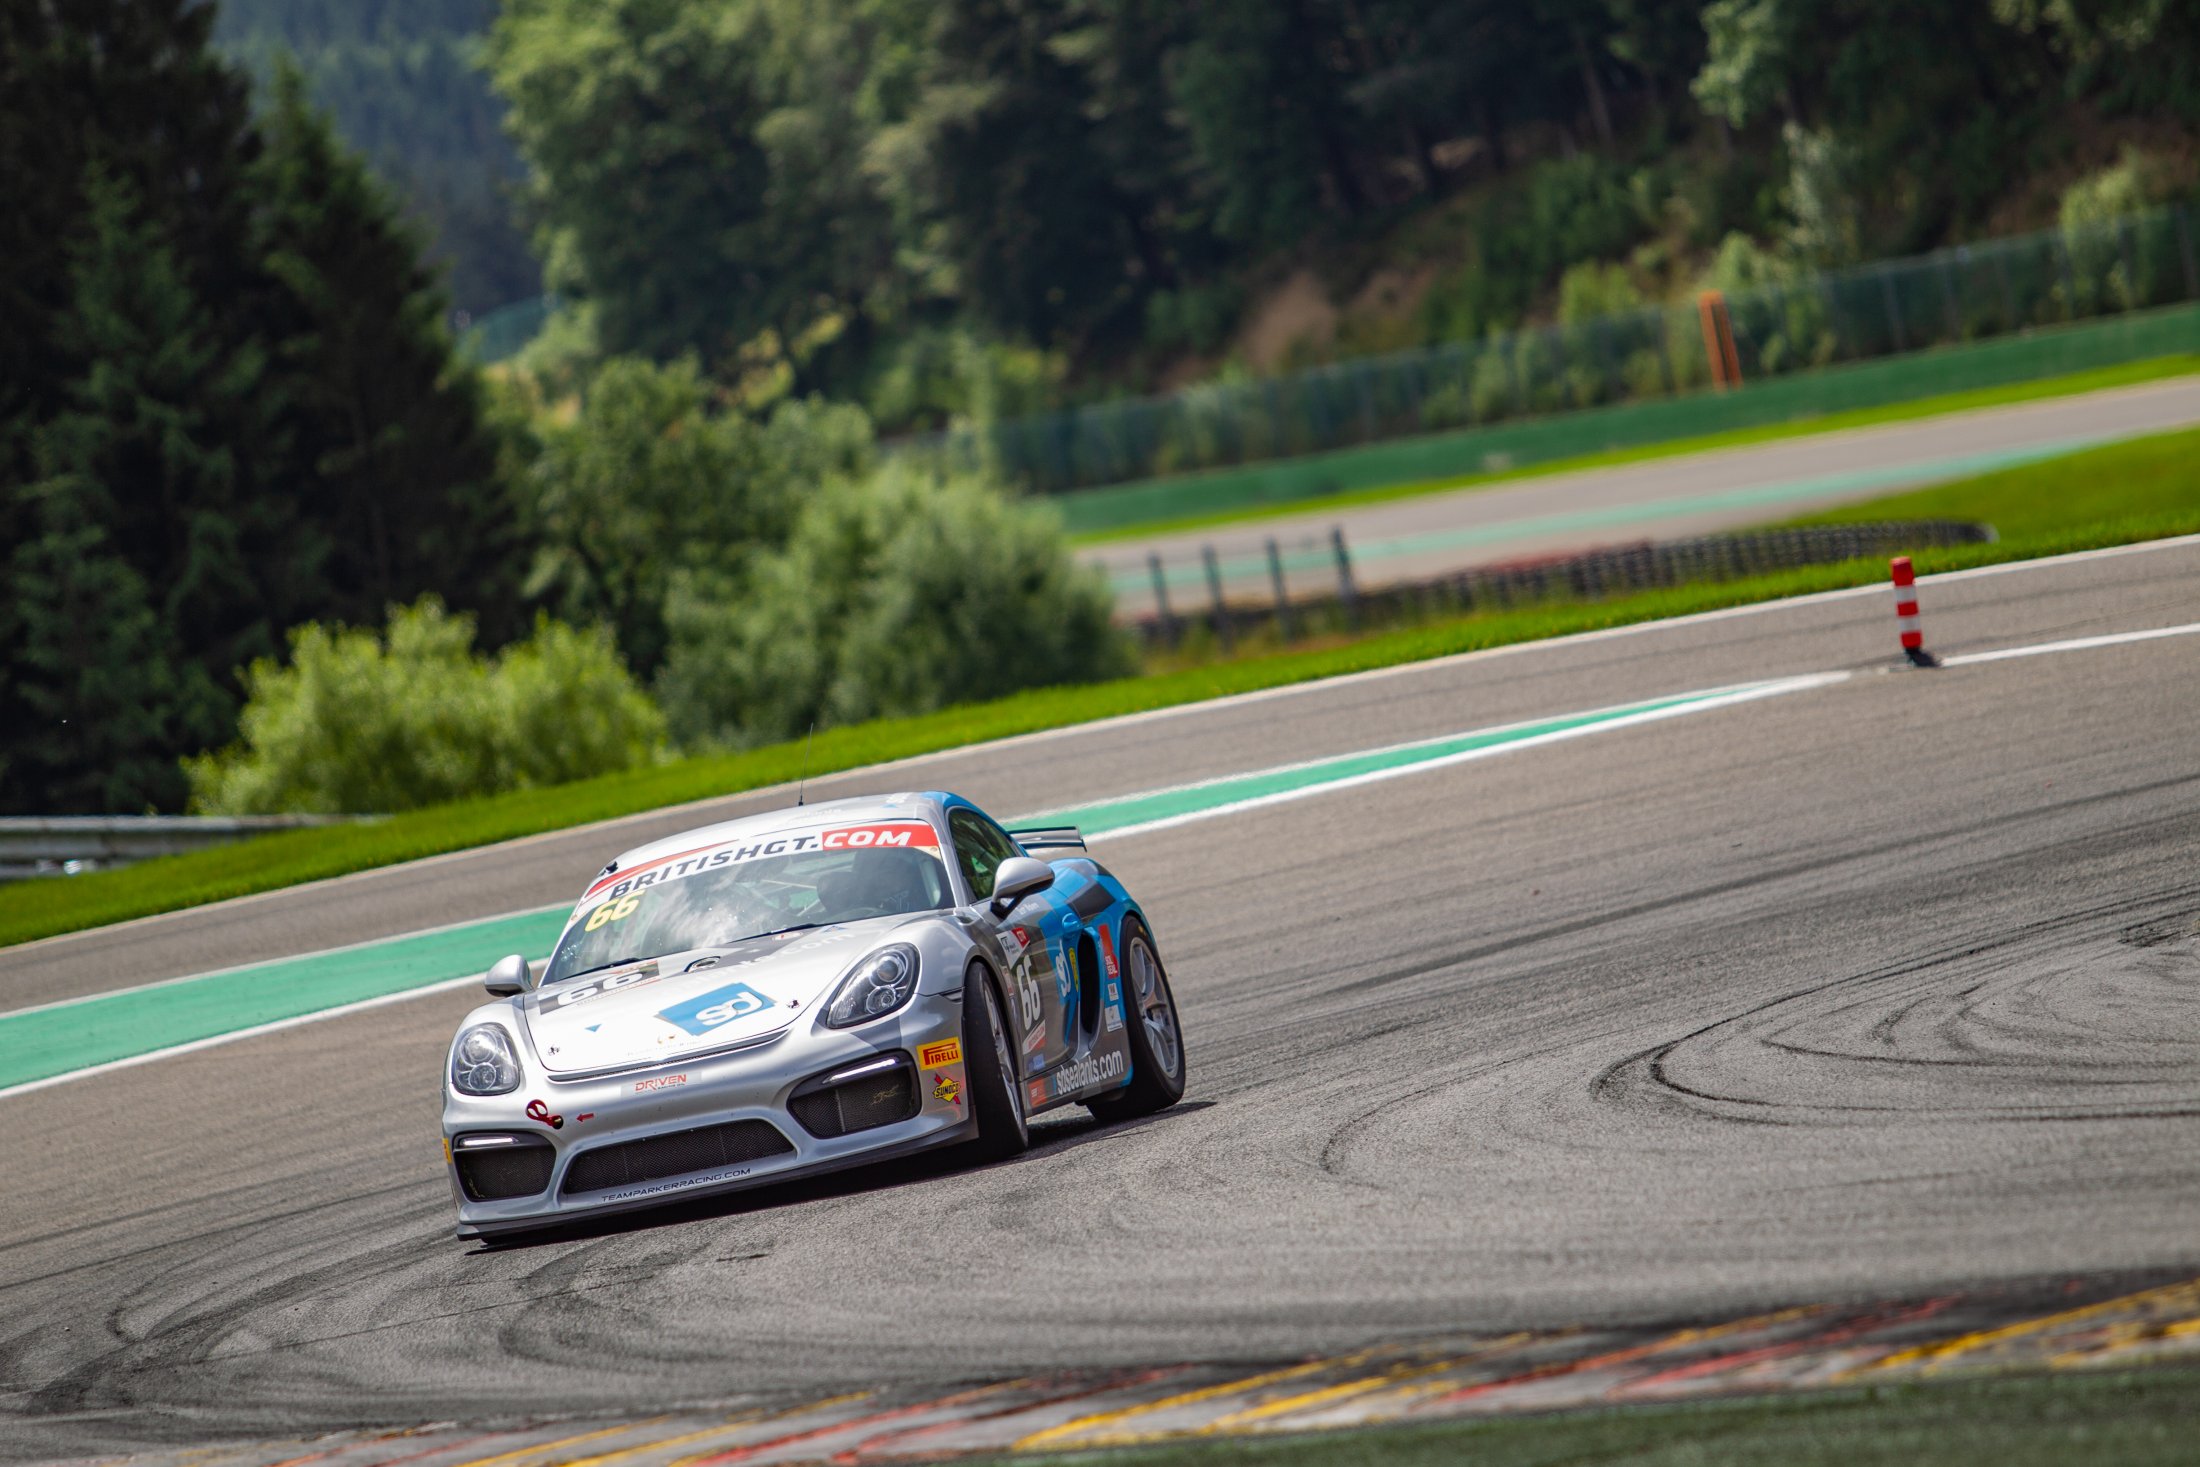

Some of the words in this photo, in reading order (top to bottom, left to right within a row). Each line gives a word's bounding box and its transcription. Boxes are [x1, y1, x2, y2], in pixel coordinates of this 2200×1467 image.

[609, 830, 912, 900] BRITISHGT.COM
[584, 890, 646, 932] 66
[557, 969, 644, 1007] 66
[1016, 954, 1041, 1031] 66
[923, 1042, 959, 1066] PIRELLI
[1056, 1050, 1124, 1095] sdsealants.com
[635, 1074, 687, 1092] DRIVEN
[602, 1168, 751, 1202] TEAMPARKERRACING.COM
